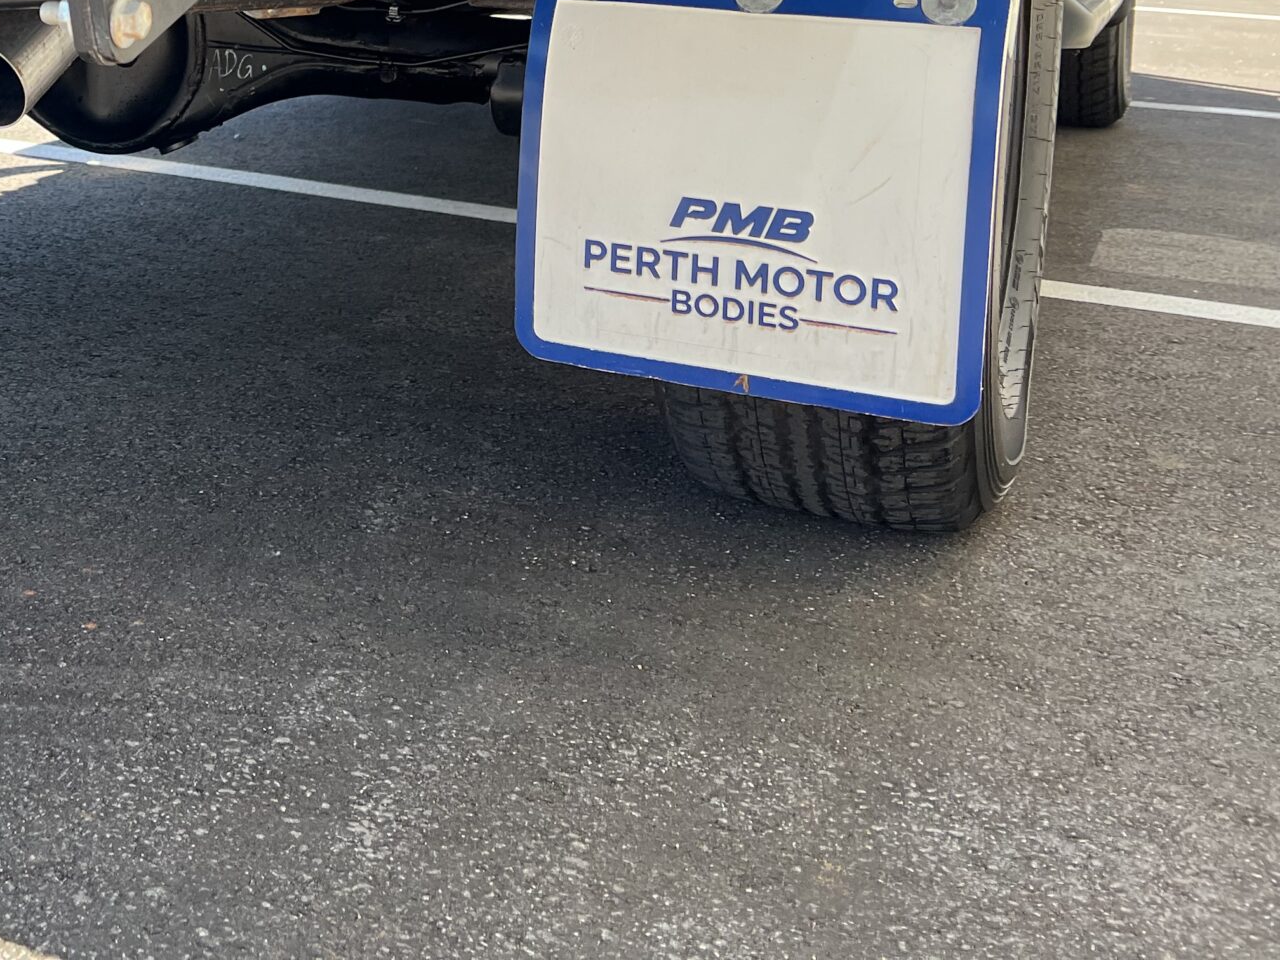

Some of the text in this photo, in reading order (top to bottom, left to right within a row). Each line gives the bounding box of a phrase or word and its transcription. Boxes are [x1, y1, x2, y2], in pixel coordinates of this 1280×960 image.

[669, 196, 815, 243] PMB
[583, 238, 898, 312] PERTH MOTOR
[670, 289, 800, 331] BODIES
